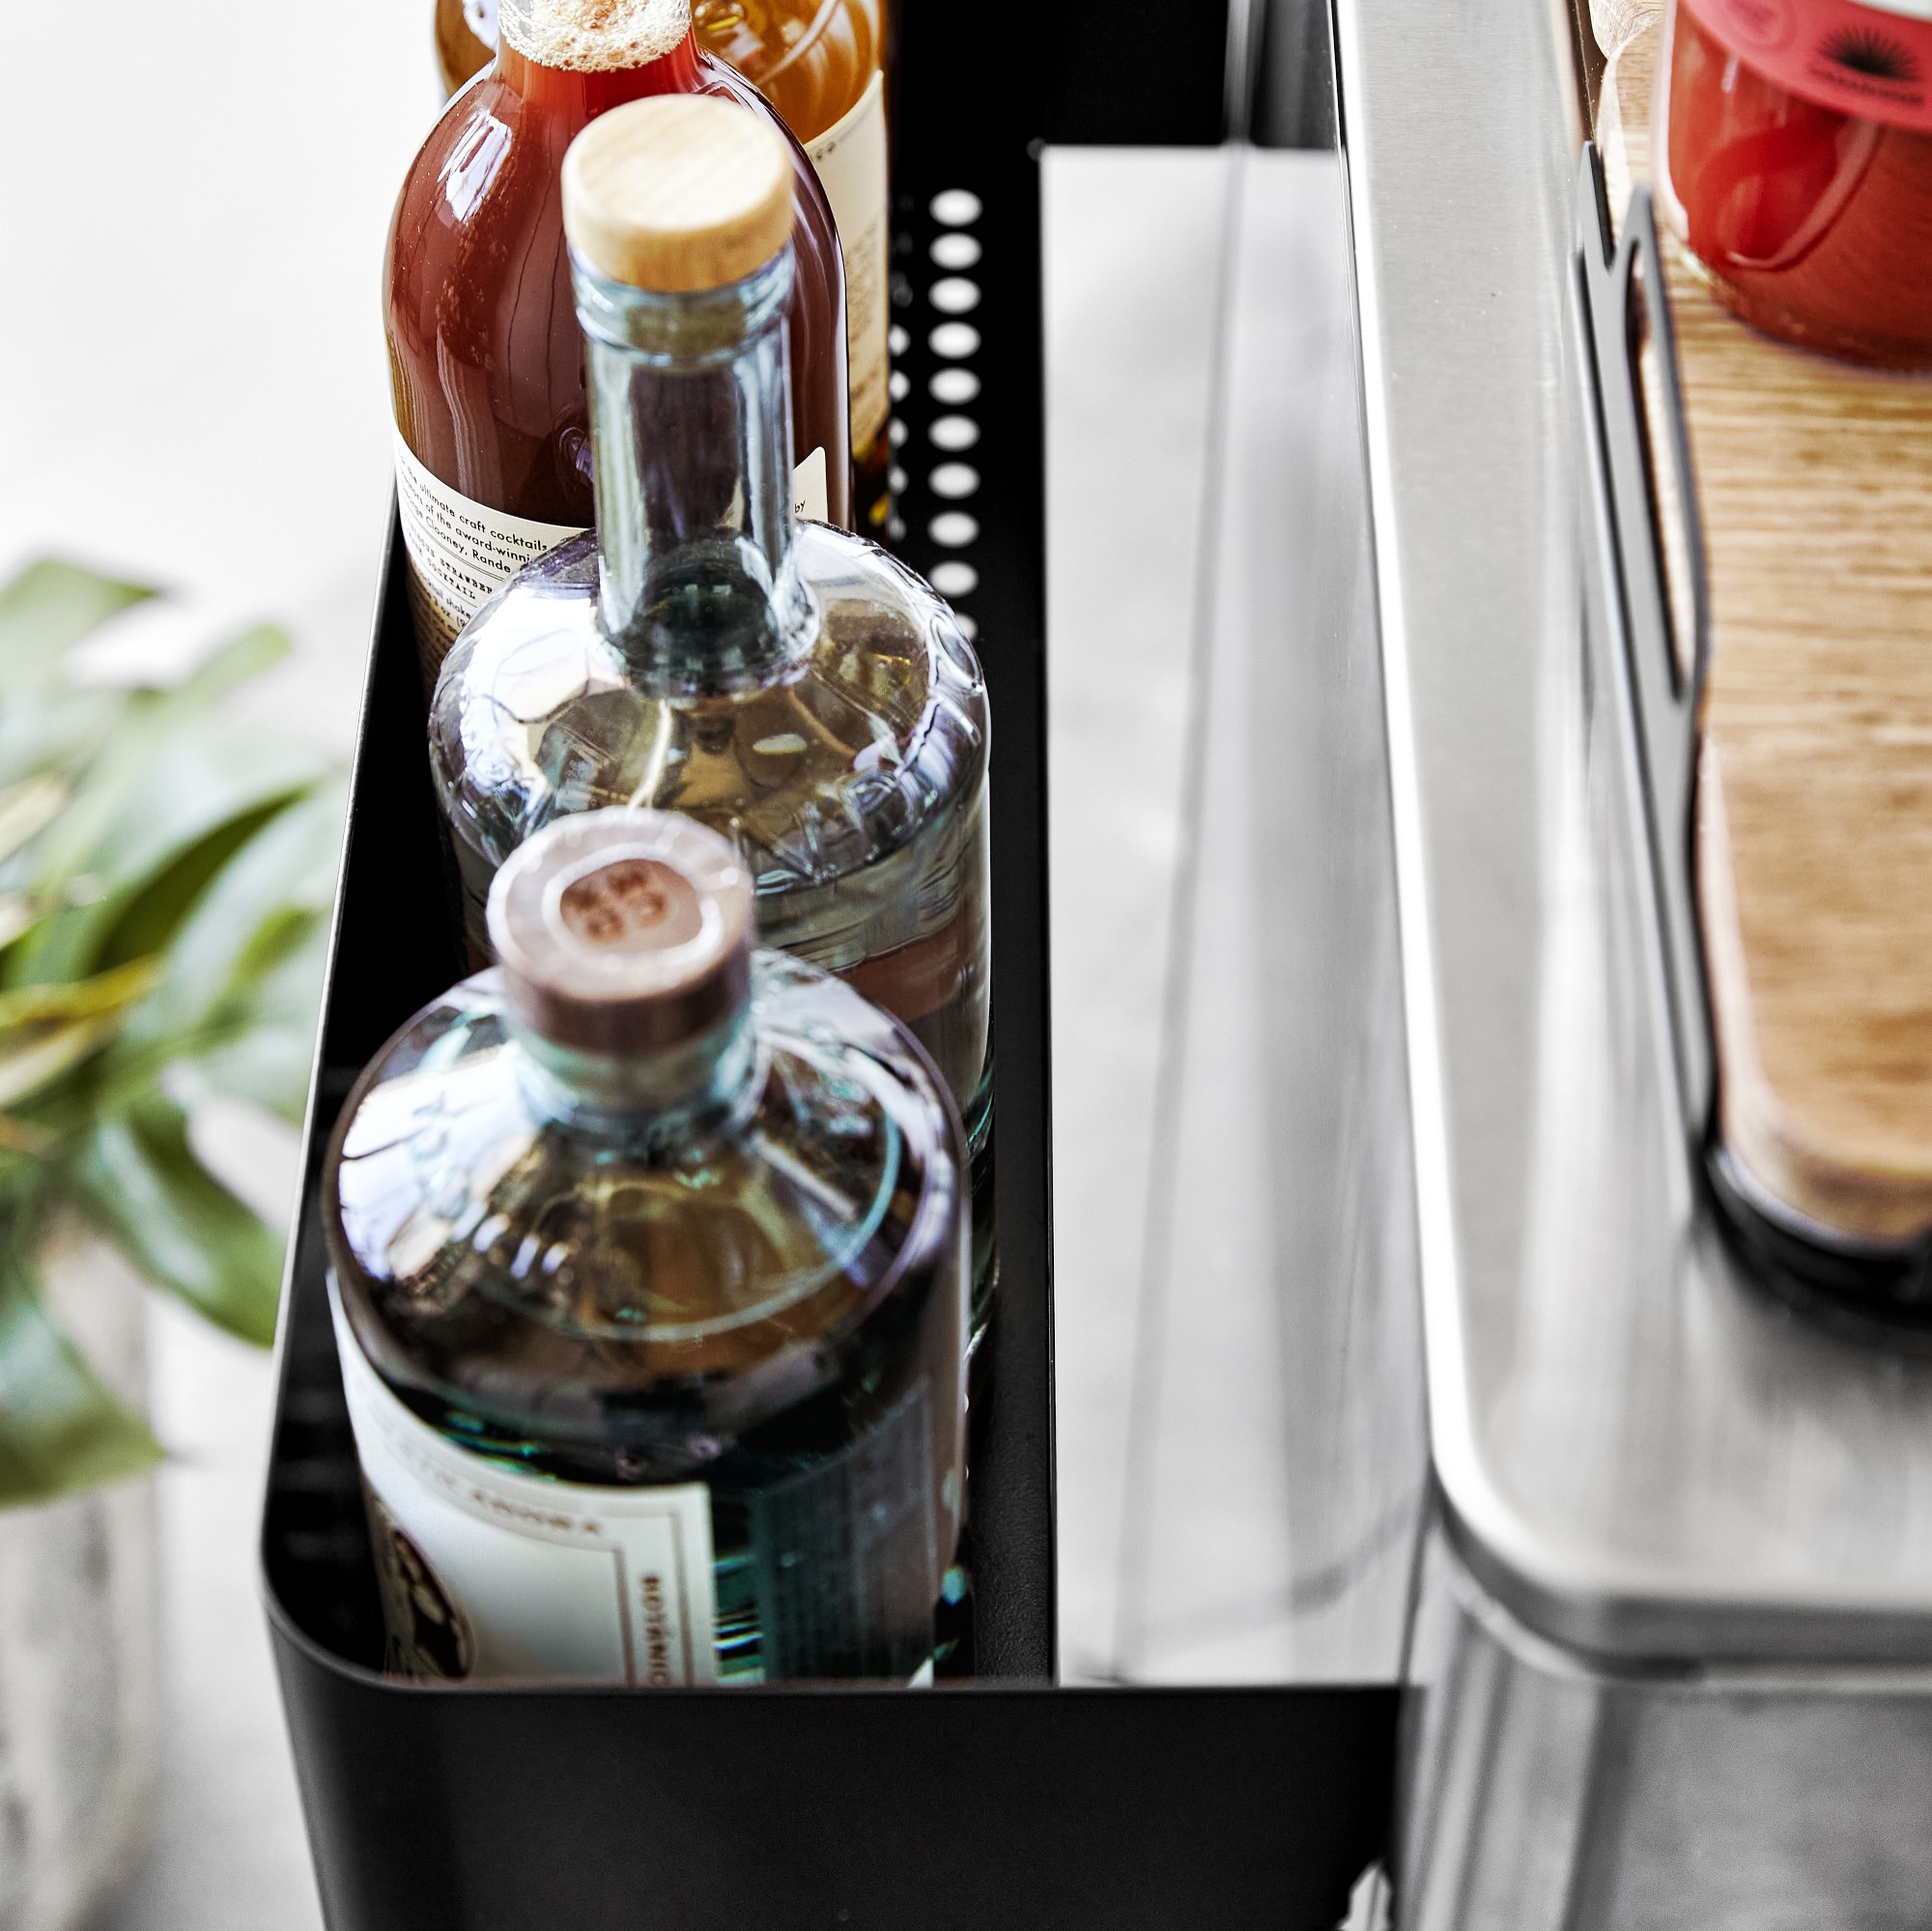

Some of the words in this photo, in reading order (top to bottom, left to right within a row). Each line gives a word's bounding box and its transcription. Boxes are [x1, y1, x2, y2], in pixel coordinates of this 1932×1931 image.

[419, 483, 455, 517] ultimate
[459, 515, 486, 533] craft
[490, 529, 548, 552] cocktails
[425, 504, 434, 515] of
[437, 511, 452, 529] the
[794, 499, 807, 513] by
[472, 548, 511, 573] Rande
[427, 557, 476, 600] COCKTAIL
[446, 597, 472, 619] shake
